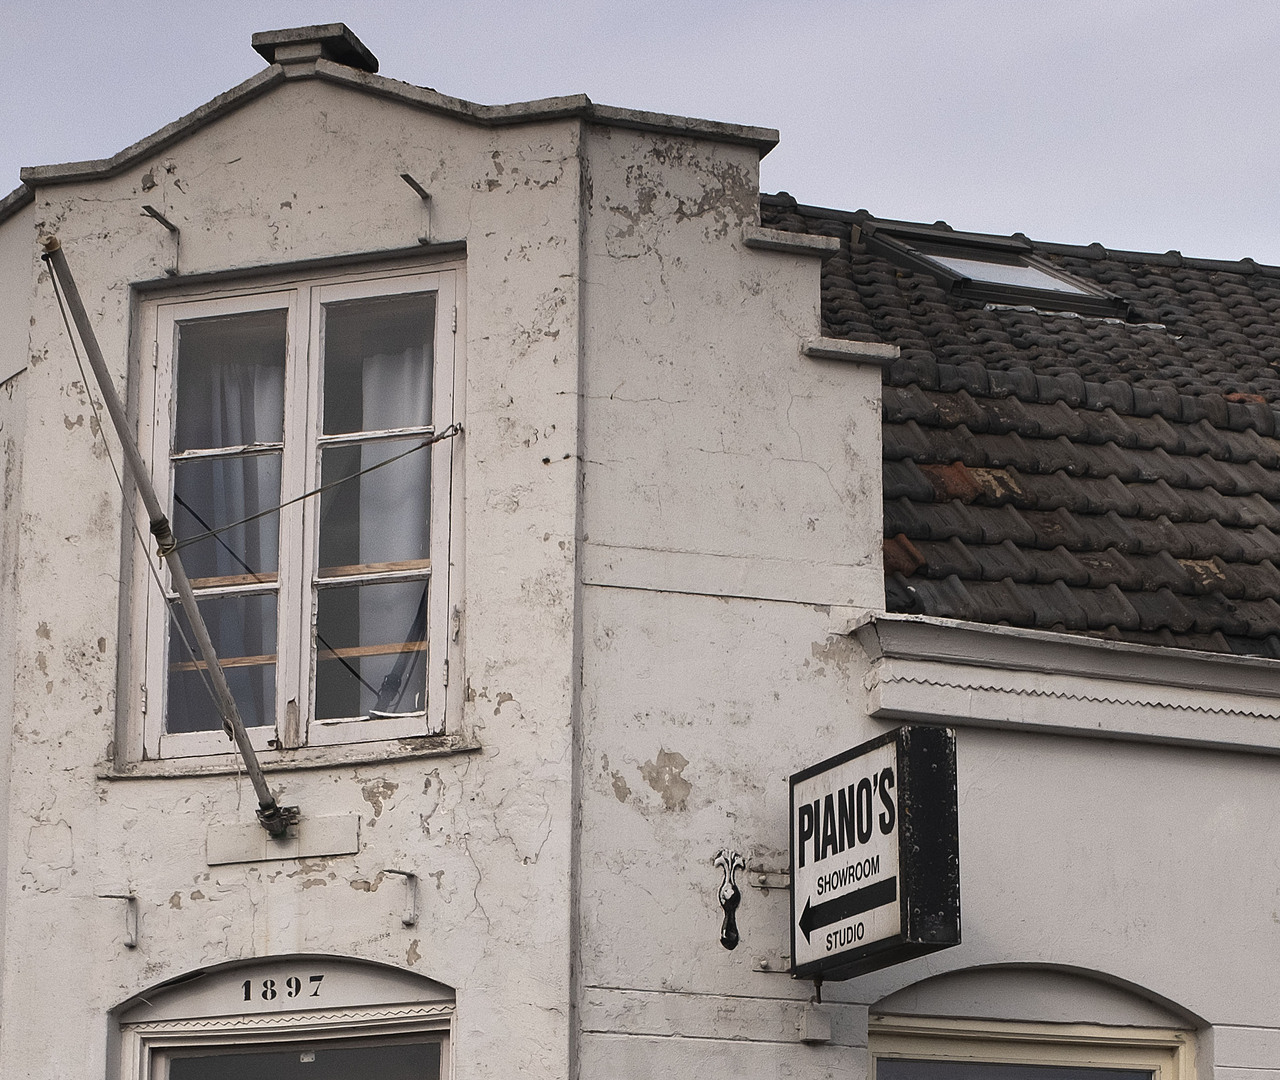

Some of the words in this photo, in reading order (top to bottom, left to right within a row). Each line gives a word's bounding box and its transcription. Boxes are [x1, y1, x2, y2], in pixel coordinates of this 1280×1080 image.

[798, 766, 895, 869] PIANO'S
[817, 855, 880, 895] SHOWROOM
[826, 922, 865, 952] STUDIO
[241, 974, 325, 1001] 1897
